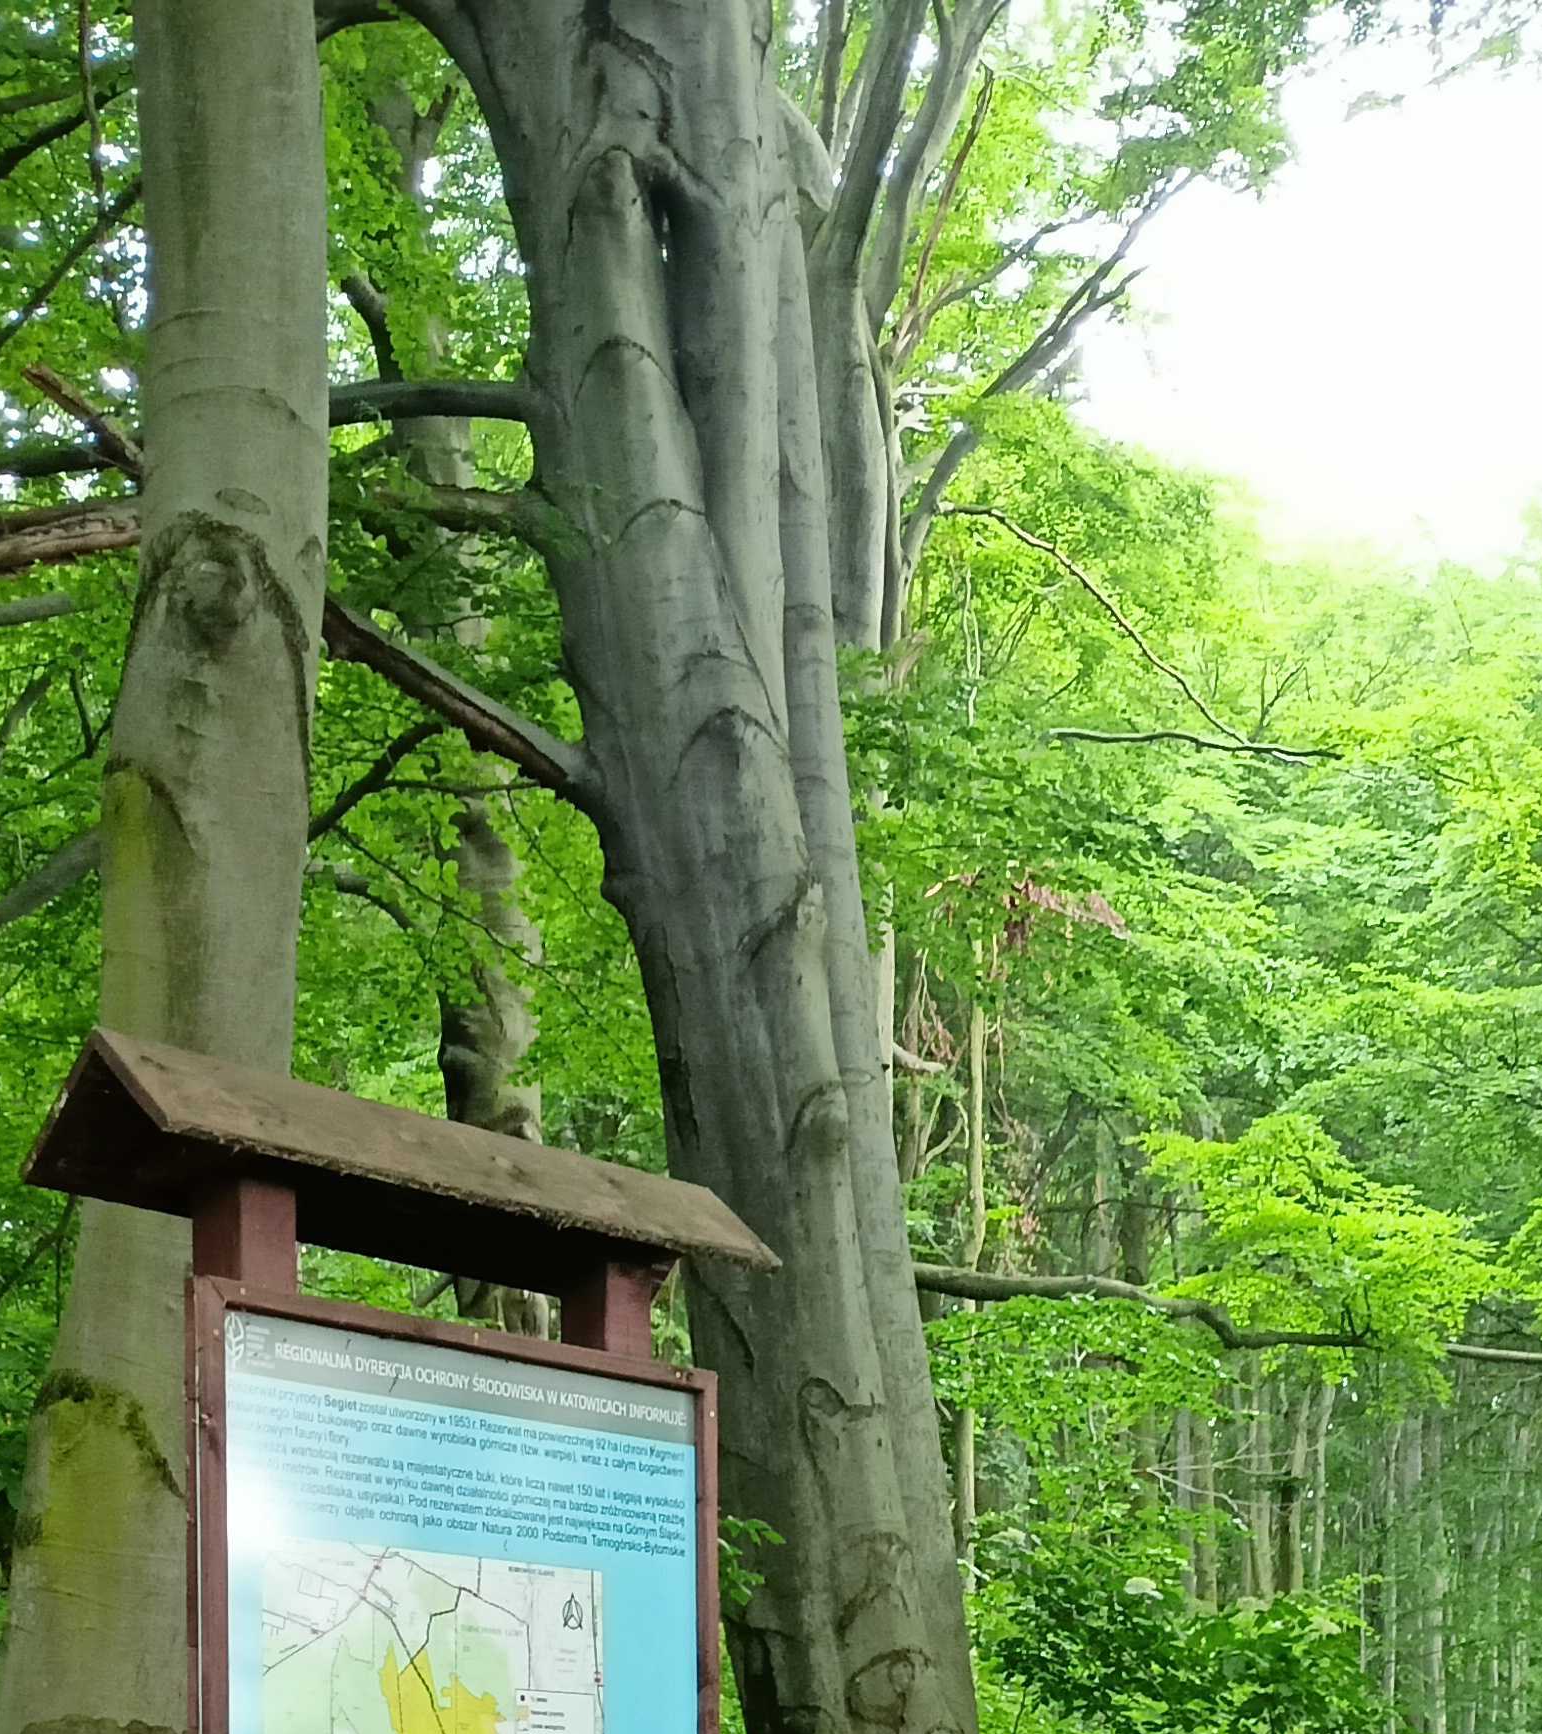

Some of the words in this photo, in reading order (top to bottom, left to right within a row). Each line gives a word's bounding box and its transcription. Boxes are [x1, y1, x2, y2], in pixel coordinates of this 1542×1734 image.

[274, 1342, 352, 1370] REGIONALNA
[355, 1356, 412, 1382] DYREKCJA
[414, 1366, 470, 1390] OCHRONY
[472, 1372, 544, 1402] ŚRODOWISKA
[546, 1390, 557, 1405] W
[560, 1392, 627, 1418] KATOWICACH
[629, 1403, 688, 1427] INFORMUJE:
[324, 1394, 358, 1411] Segiet
[438, 1416, 446, 1424] w
[479, 1419, 522, 1437] Rezerwat
[371, 1423, 392, 1434] oraz
